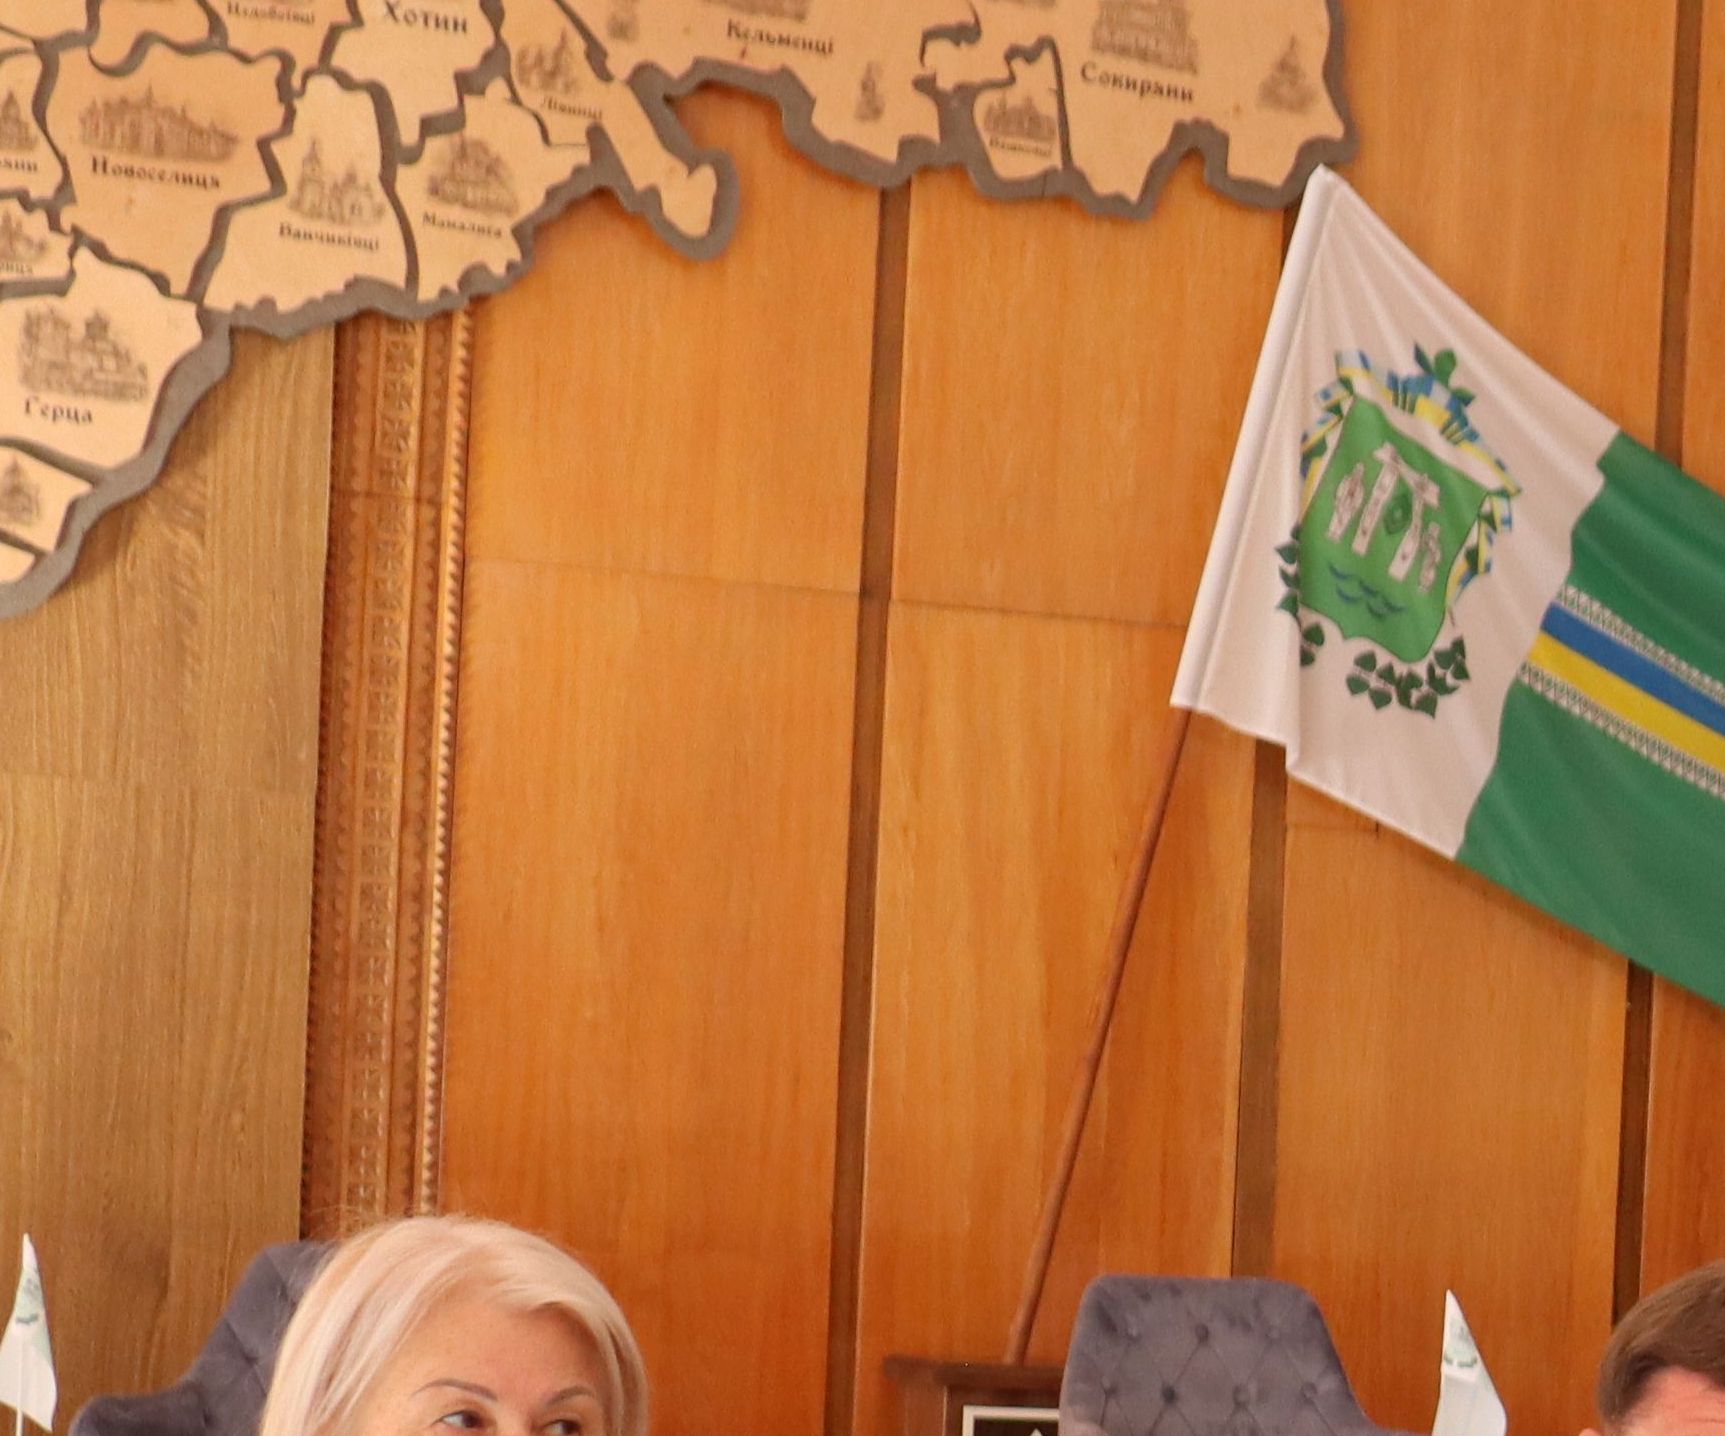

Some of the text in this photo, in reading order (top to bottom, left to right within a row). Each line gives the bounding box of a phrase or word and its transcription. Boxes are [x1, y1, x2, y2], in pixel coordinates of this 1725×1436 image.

[384, 1, 468, 34] Хотин
[1080, 61, 1194, 103] Сокиряни
[91, 154, 221, 190] Новоселиця
[23, 395, 94, 425] Герца
